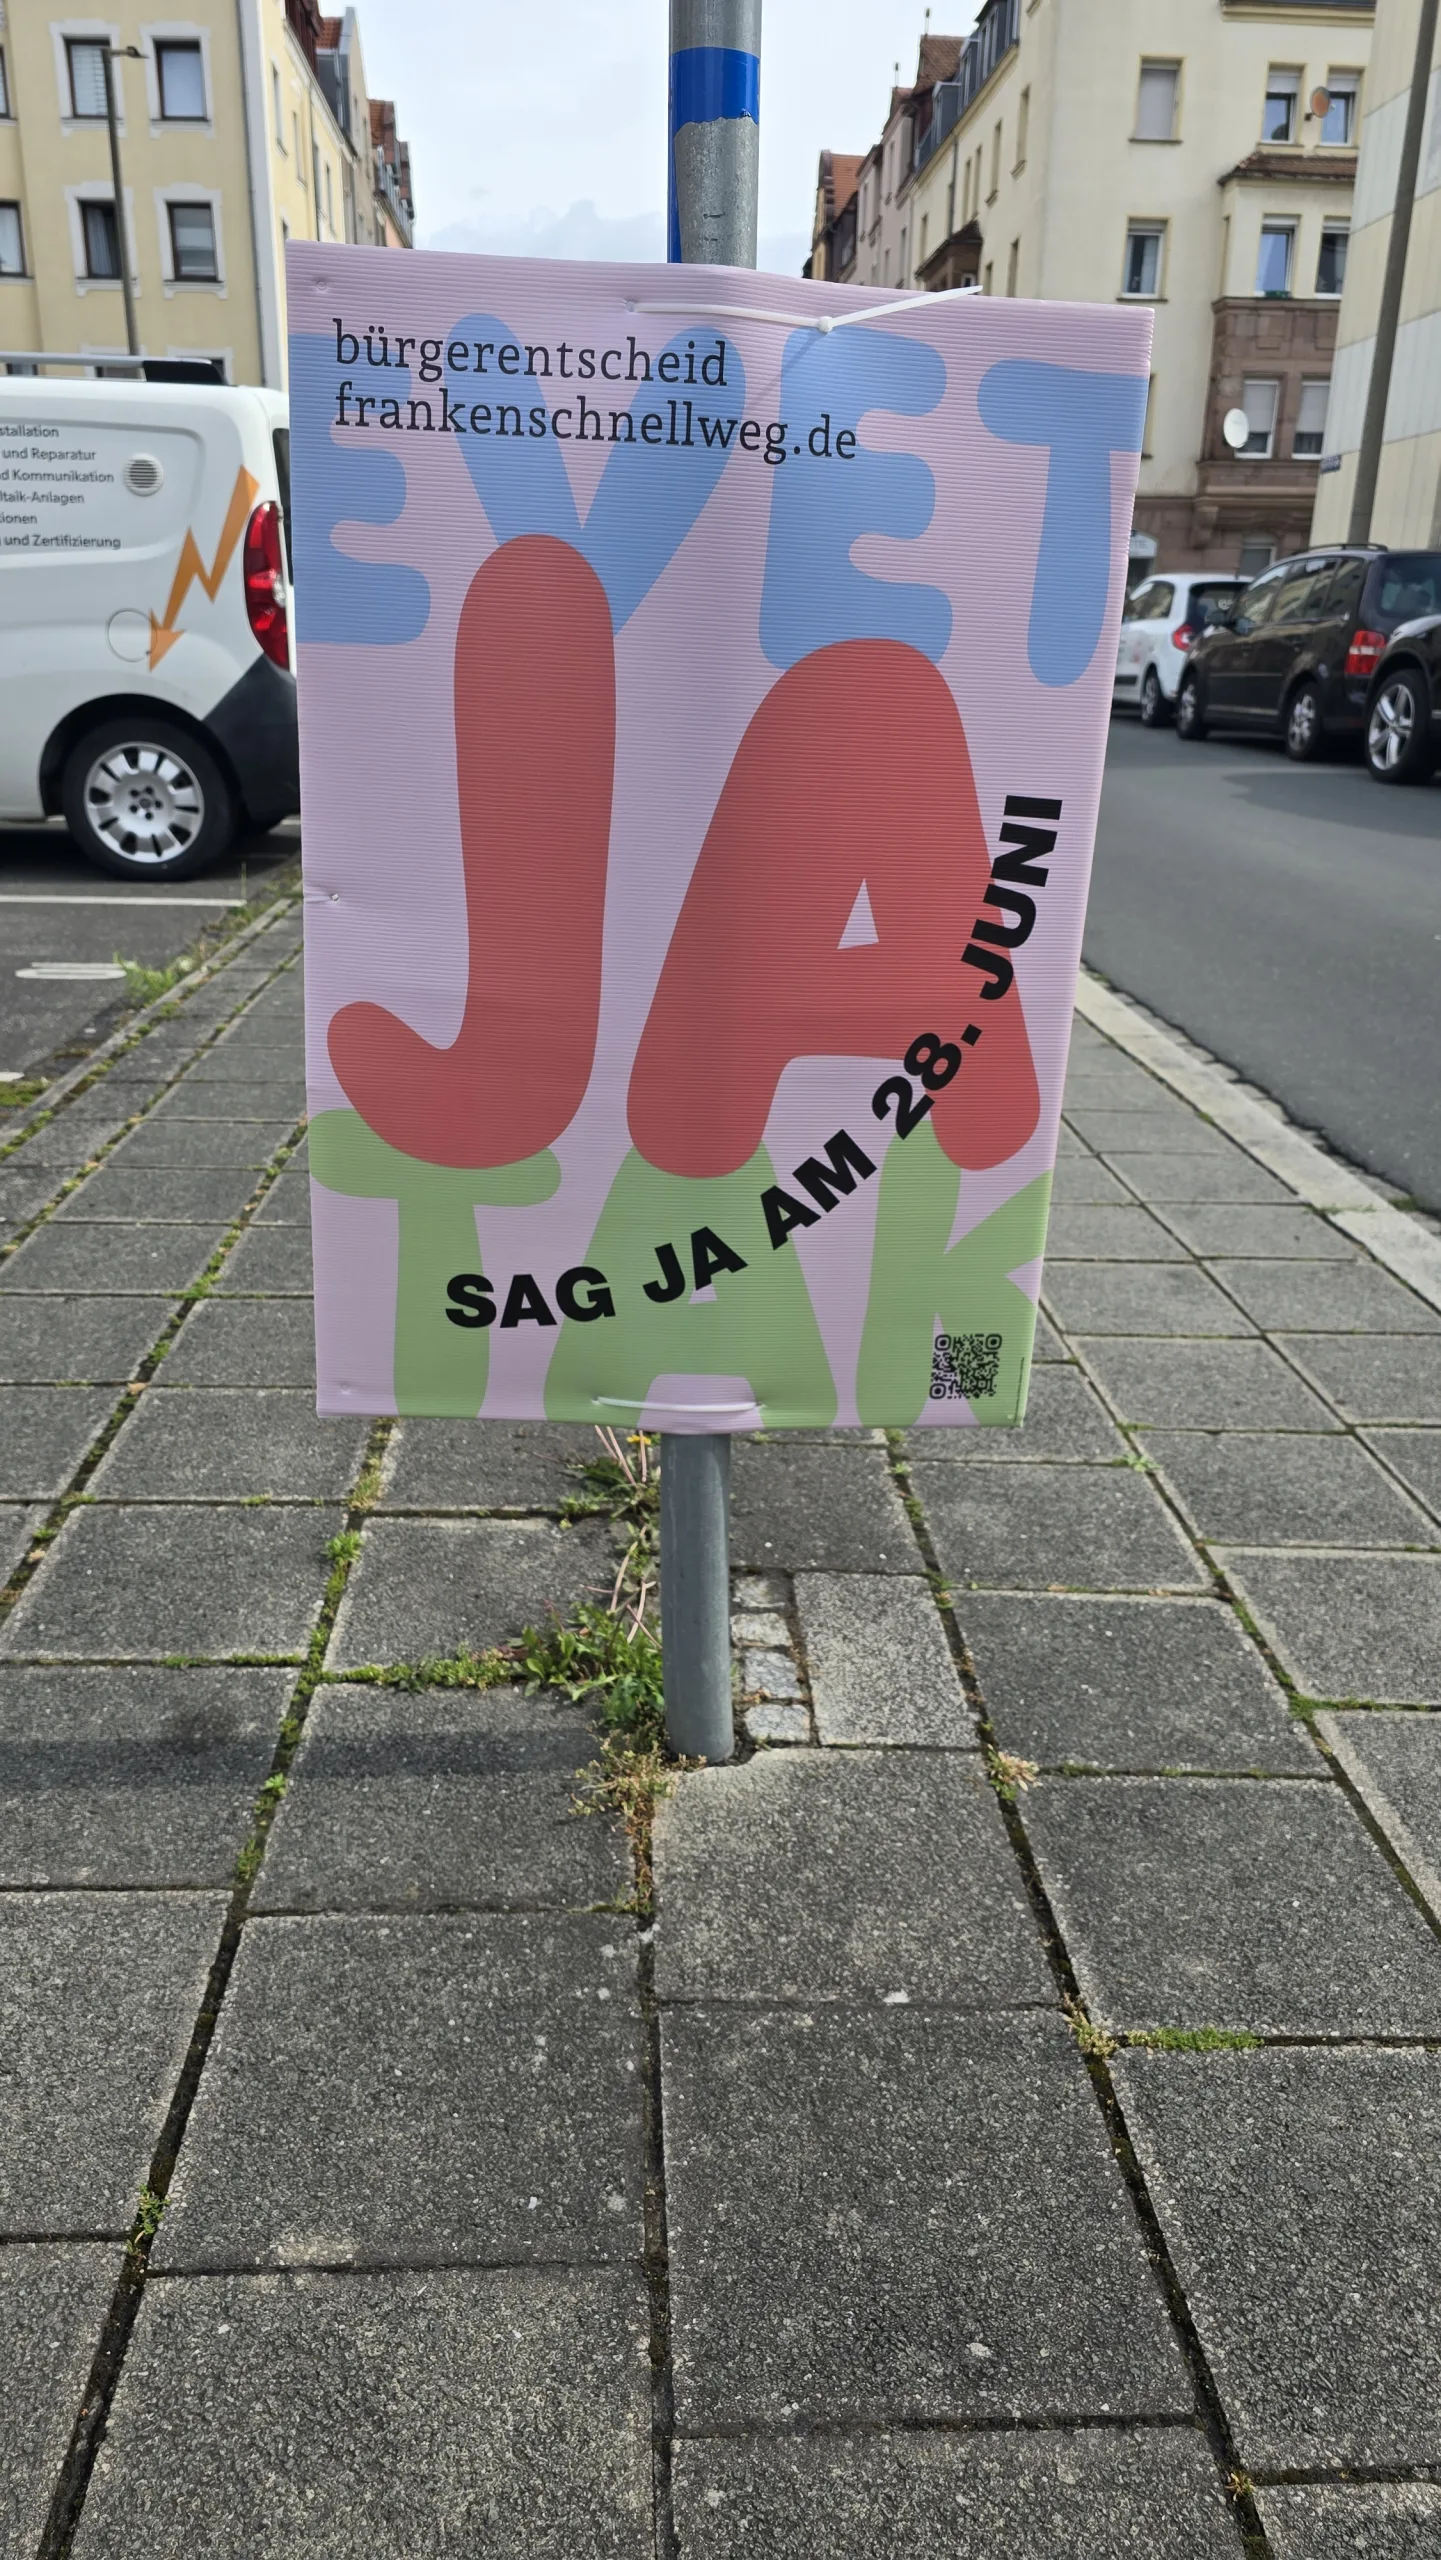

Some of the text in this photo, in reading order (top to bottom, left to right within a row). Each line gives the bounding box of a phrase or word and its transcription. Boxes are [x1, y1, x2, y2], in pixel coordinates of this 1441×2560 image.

[333, 317, 728, 387] bürgerentscheid
[2, 446, 97, 462] und Reparatur
[334, 380, 857, 465] frankenschnellweg.de
[12, 468, 115, 482] Kommunikation
[4, 533, 30, 547] und
[32, 534, 122, 551] Zertifizierung
[327, 535, 1040, 1178] JA
[446, 795, 1063, 1329] SAG JA AM 28. JUNI
[308, 1108, 1053, 1428] TAK
